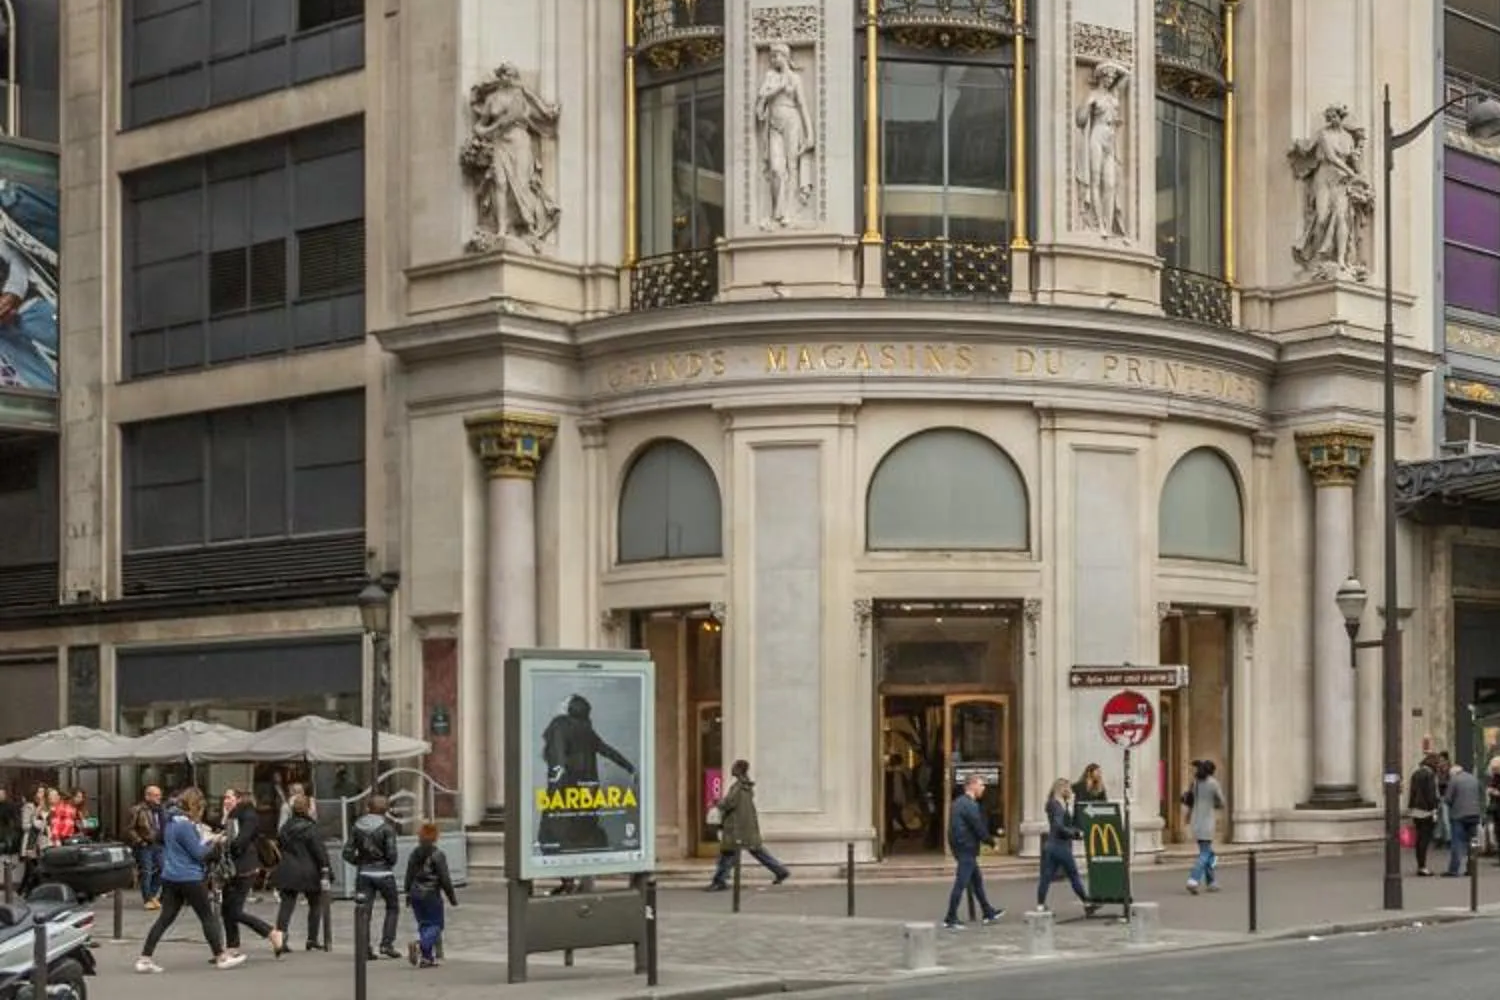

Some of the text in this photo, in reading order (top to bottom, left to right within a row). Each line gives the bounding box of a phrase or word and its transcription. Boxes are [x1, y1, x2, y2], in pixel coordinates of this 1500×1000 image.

[607, 342, 1258, 405] GRANDS MAGASINS DU PRINTEMPS
[535, 785, 638, 812] BARBARA
